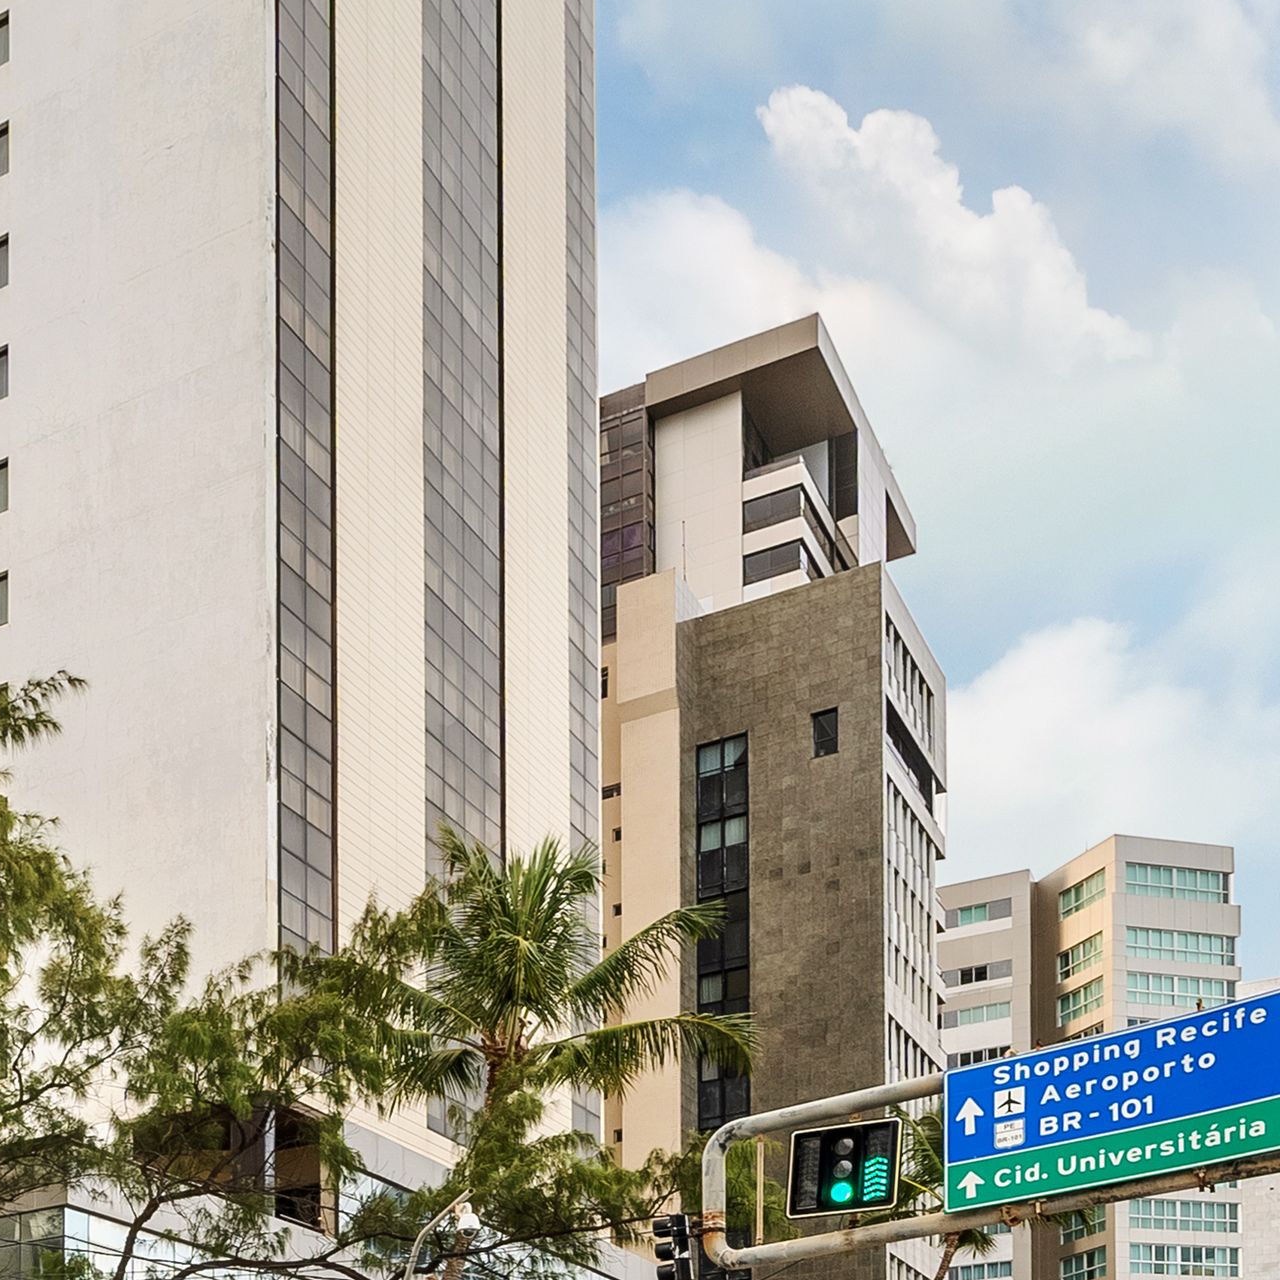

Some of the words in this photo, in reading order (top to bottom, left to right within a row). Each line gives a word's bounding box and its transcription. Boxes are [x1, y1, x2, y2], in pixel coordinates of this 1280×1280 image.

[993, 1038, 1140, 1085] Shopping
[1156, 1007, 1267, 1048] Recife
[1040, 1052, 1216, 1105] Aeroporto
[993, 1161, 1048, 1187] Cid.
[1057, 1117, 1266, 1177] Universitária
